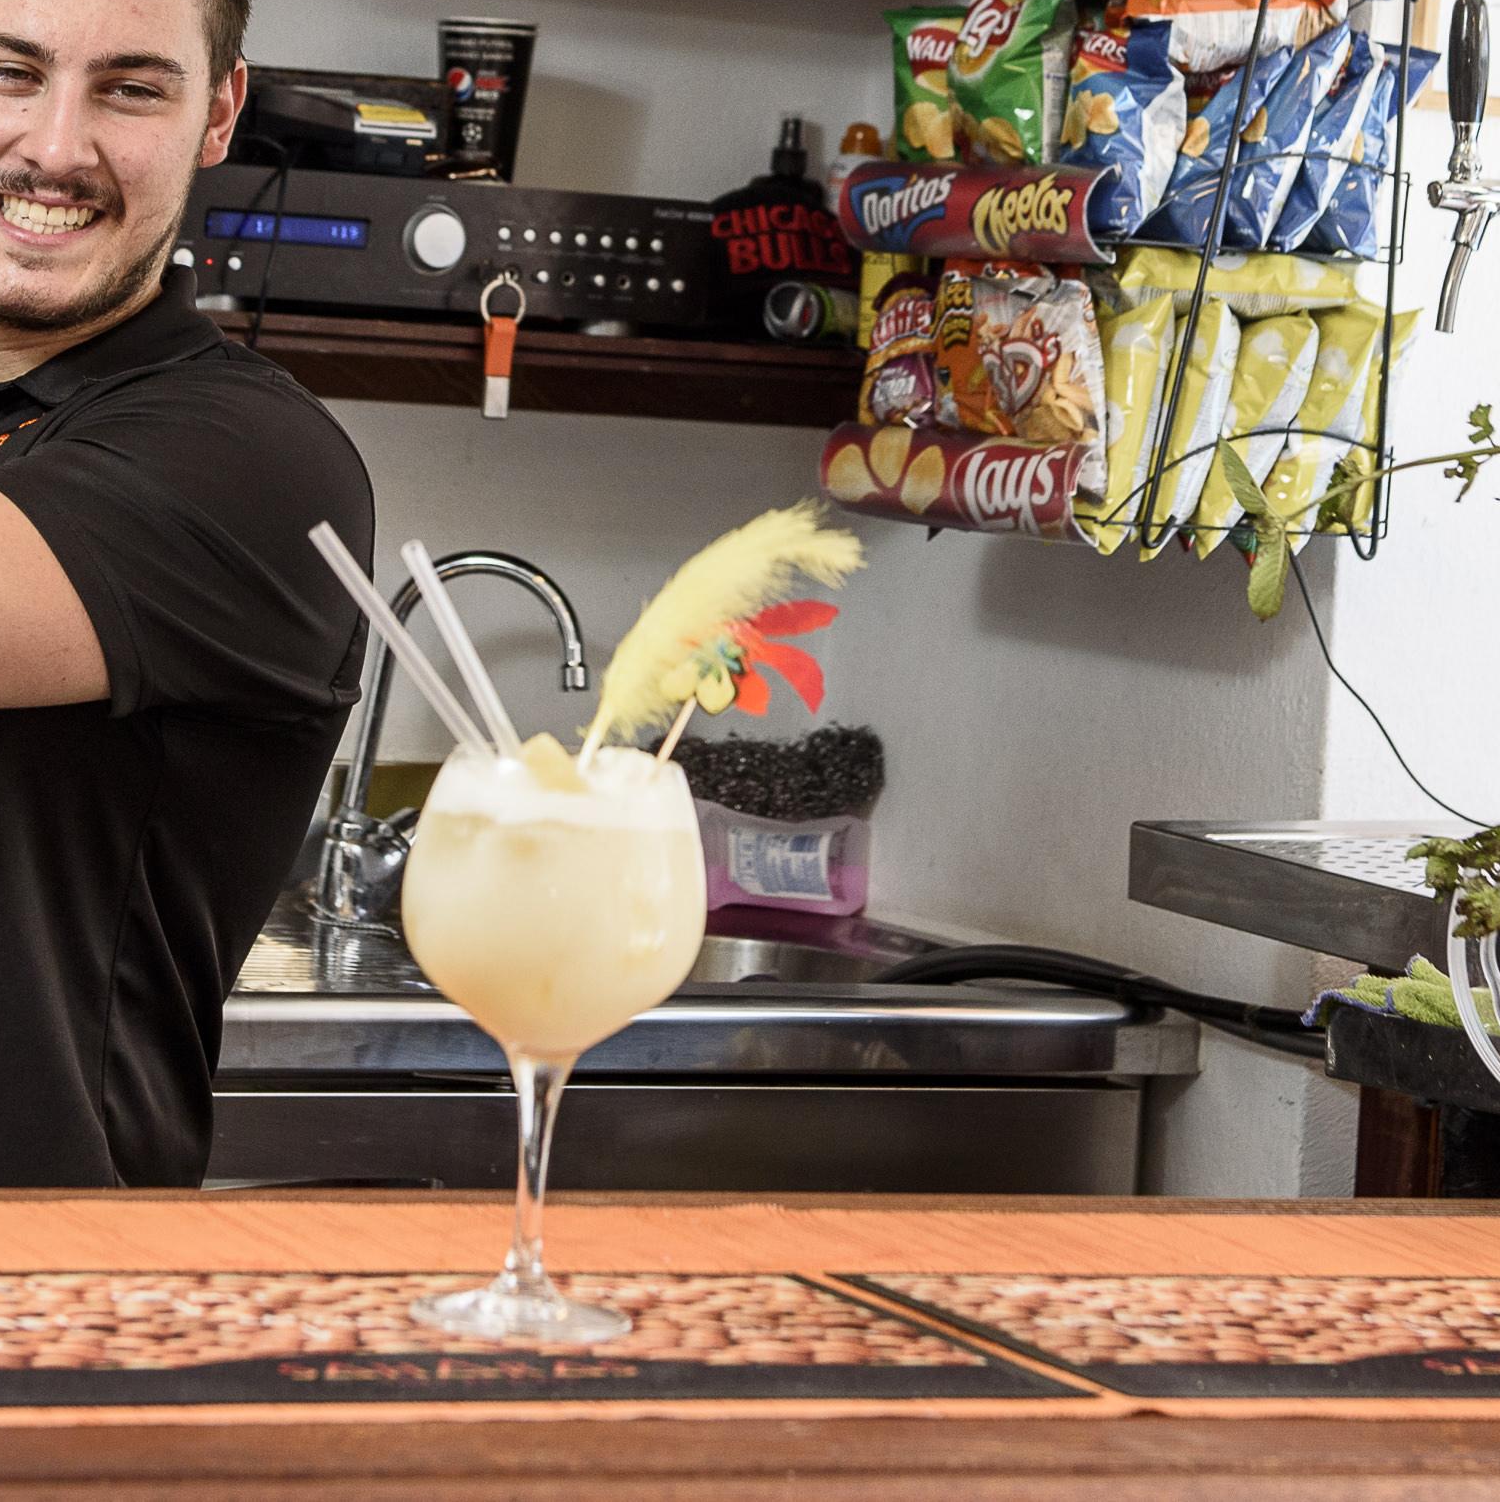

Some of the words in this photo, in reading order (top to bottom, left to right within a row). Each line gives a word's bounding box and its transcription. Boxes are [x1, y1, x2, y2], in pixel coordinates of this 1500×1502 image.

[710, 204, 845, 239] CHICAG
[862, 172, 958, 236] Doritos
[972, 170, 1074, 256] Cheetos
